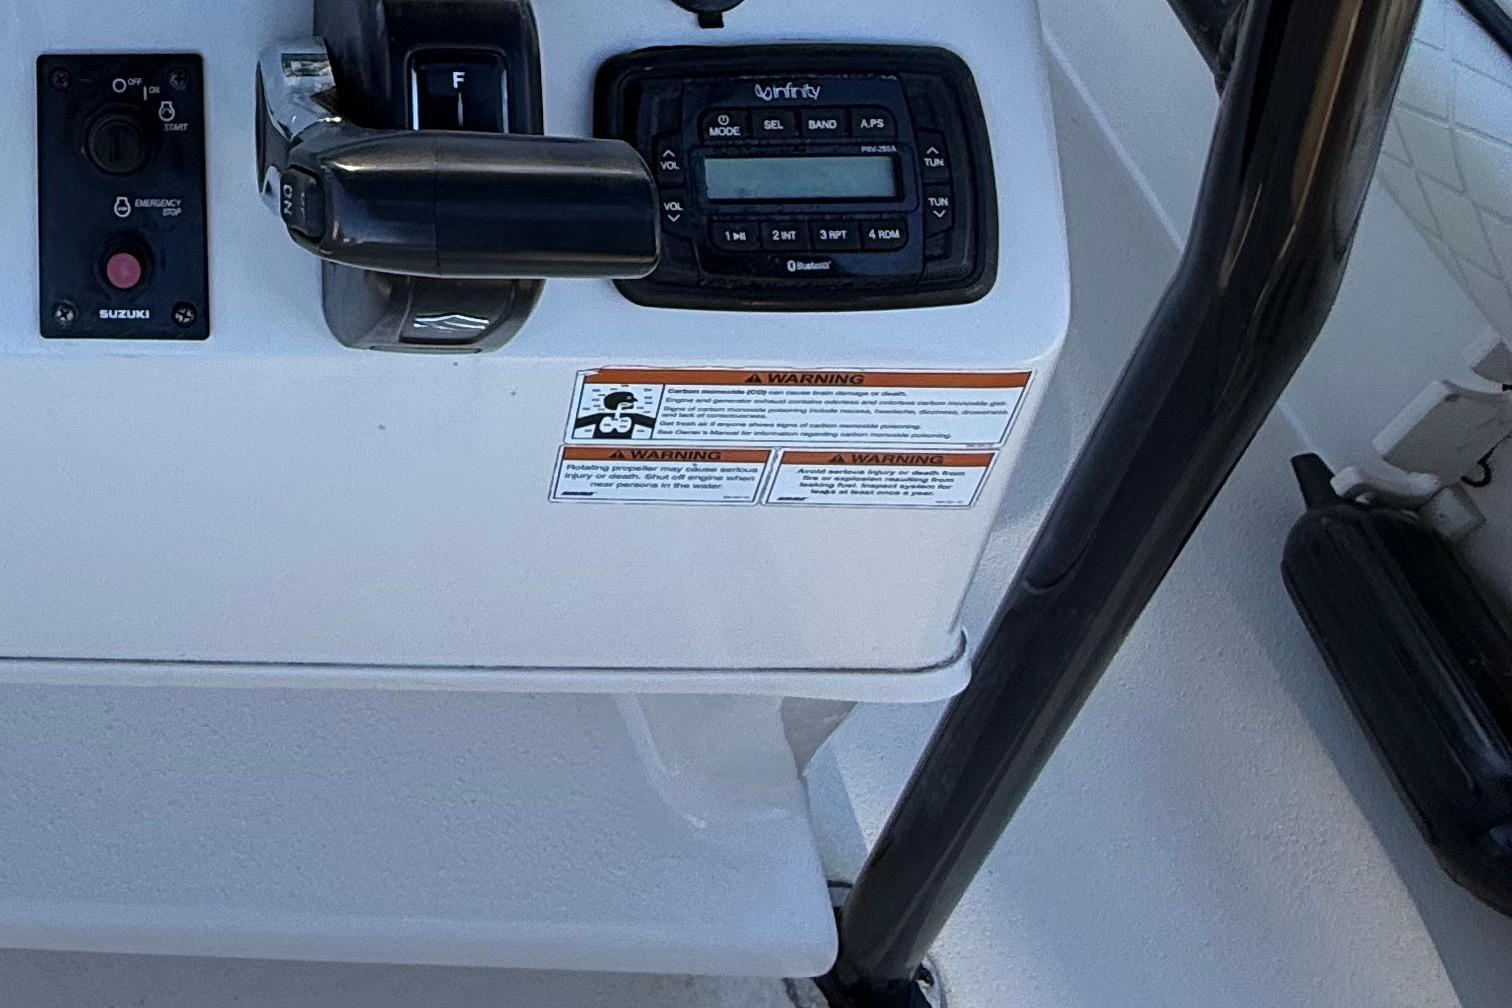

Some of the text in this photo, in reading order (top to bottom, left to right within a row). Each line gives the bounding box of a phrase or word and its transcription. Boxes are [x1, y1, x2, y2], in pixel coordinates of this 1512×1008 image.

[452, 71, 465, 89] F
[764, 120, 783, 130] SEL
[808, 120, 837, 129] BAND
[709, 127, 741, 136] MODE
[660, 161, 680, 170] VOL
[924, 158, 944, 167] TUN
[135, 198, 182, 208] EMERGENCY
[664, 202, 683, 211] VOL
[928, 197, 948, 206] TUN
[725, 231, 731, 241] 1
[772, 231, 780, 241] 2
[820, 230, 827, 239] 3
[869, 229, 900, 239] 4 RDM
[99, 309, 150, 319] SUZUKI
[768, 373, 865, 384] WARNING
[630, 449, 721, 460] WARNING
[851, 454, 944, 465] WARNING
[612, 464, 657, 472] propeller
